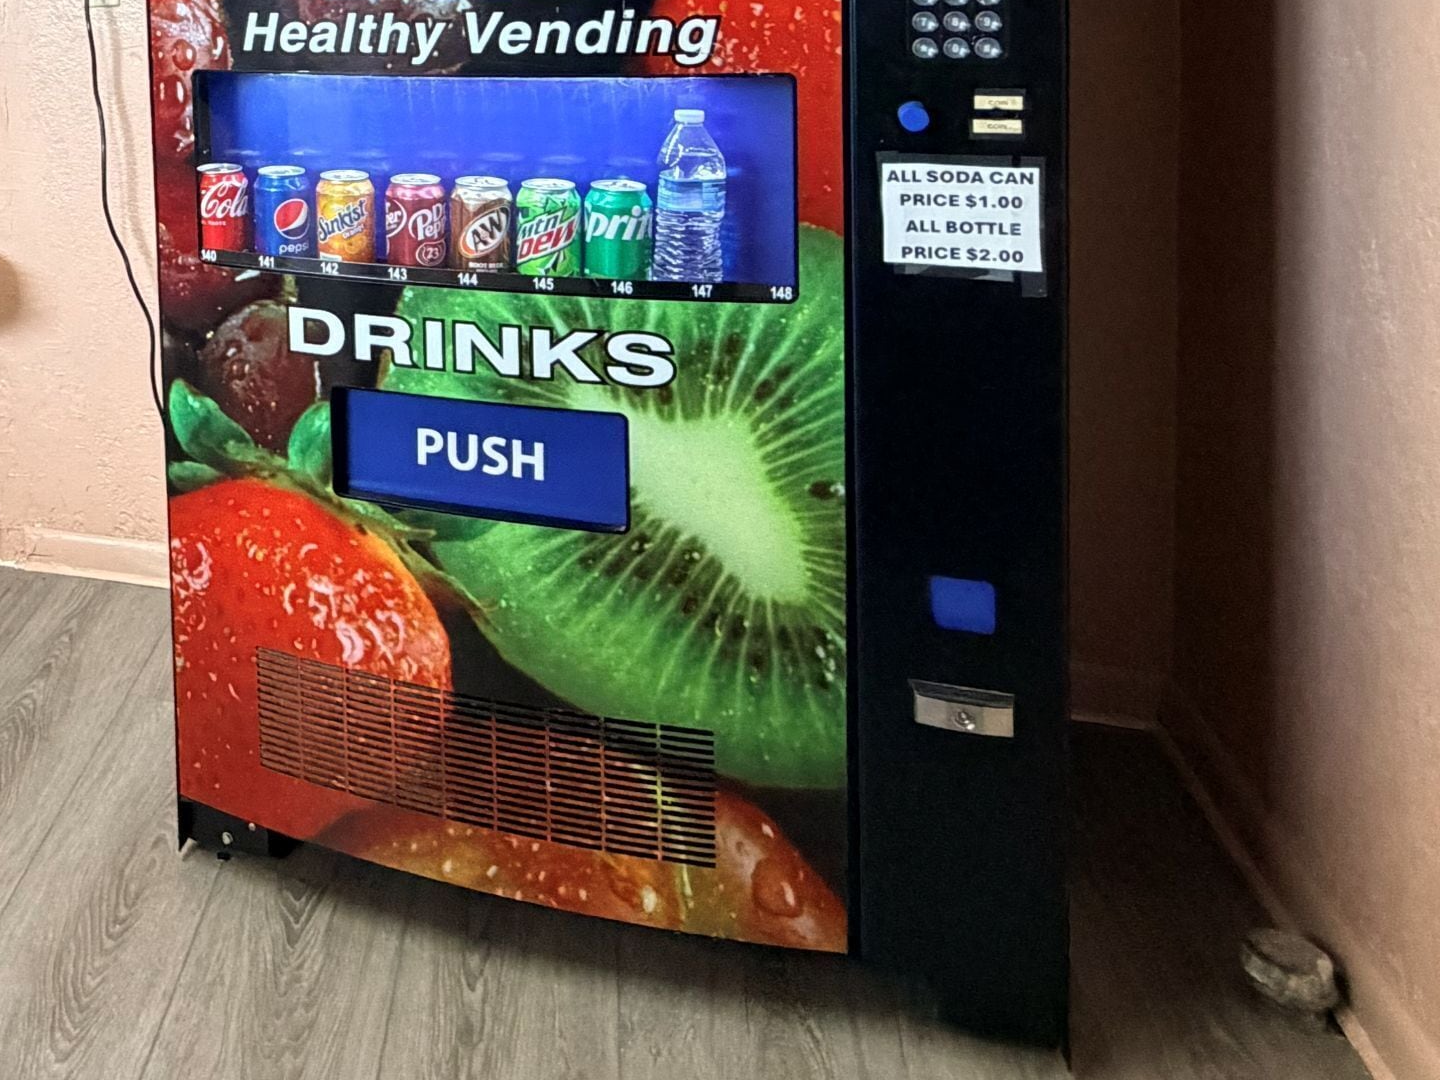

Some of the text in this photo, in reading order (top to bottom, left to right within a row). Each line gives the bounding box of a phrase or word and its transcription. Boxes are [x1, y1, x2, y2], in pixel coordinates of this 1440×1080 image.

[242, 4, 719, 65] Healthy Vending
[887, 170, 1035, 185] ALL SODA CAN
[900, 193, 1023, 209] PRICE $1.00
[319, 198, 366, 242] Sunkist
[906, 220, 1022, 236] ALL BOTTLE
[201, 249, 217, 262] 140
[426, 247, 439, 259] 23
[901, 246, 1024, 263] PRICE $2.00
[258, 256, 275, 268] 141
[320, 261, 339, 274] 142
[388, 267, 407, 280] 143
[458, 273, 478, 286] 144
[533, 278, 554, 290] 145
[611, 281, 633, 294] 146
[692, 284, 712, 297] 147
[770, 287, 793, 300] 148
[288, 306, 677, 387] DRINKS
[416, 428, 545, 481] PUSH
